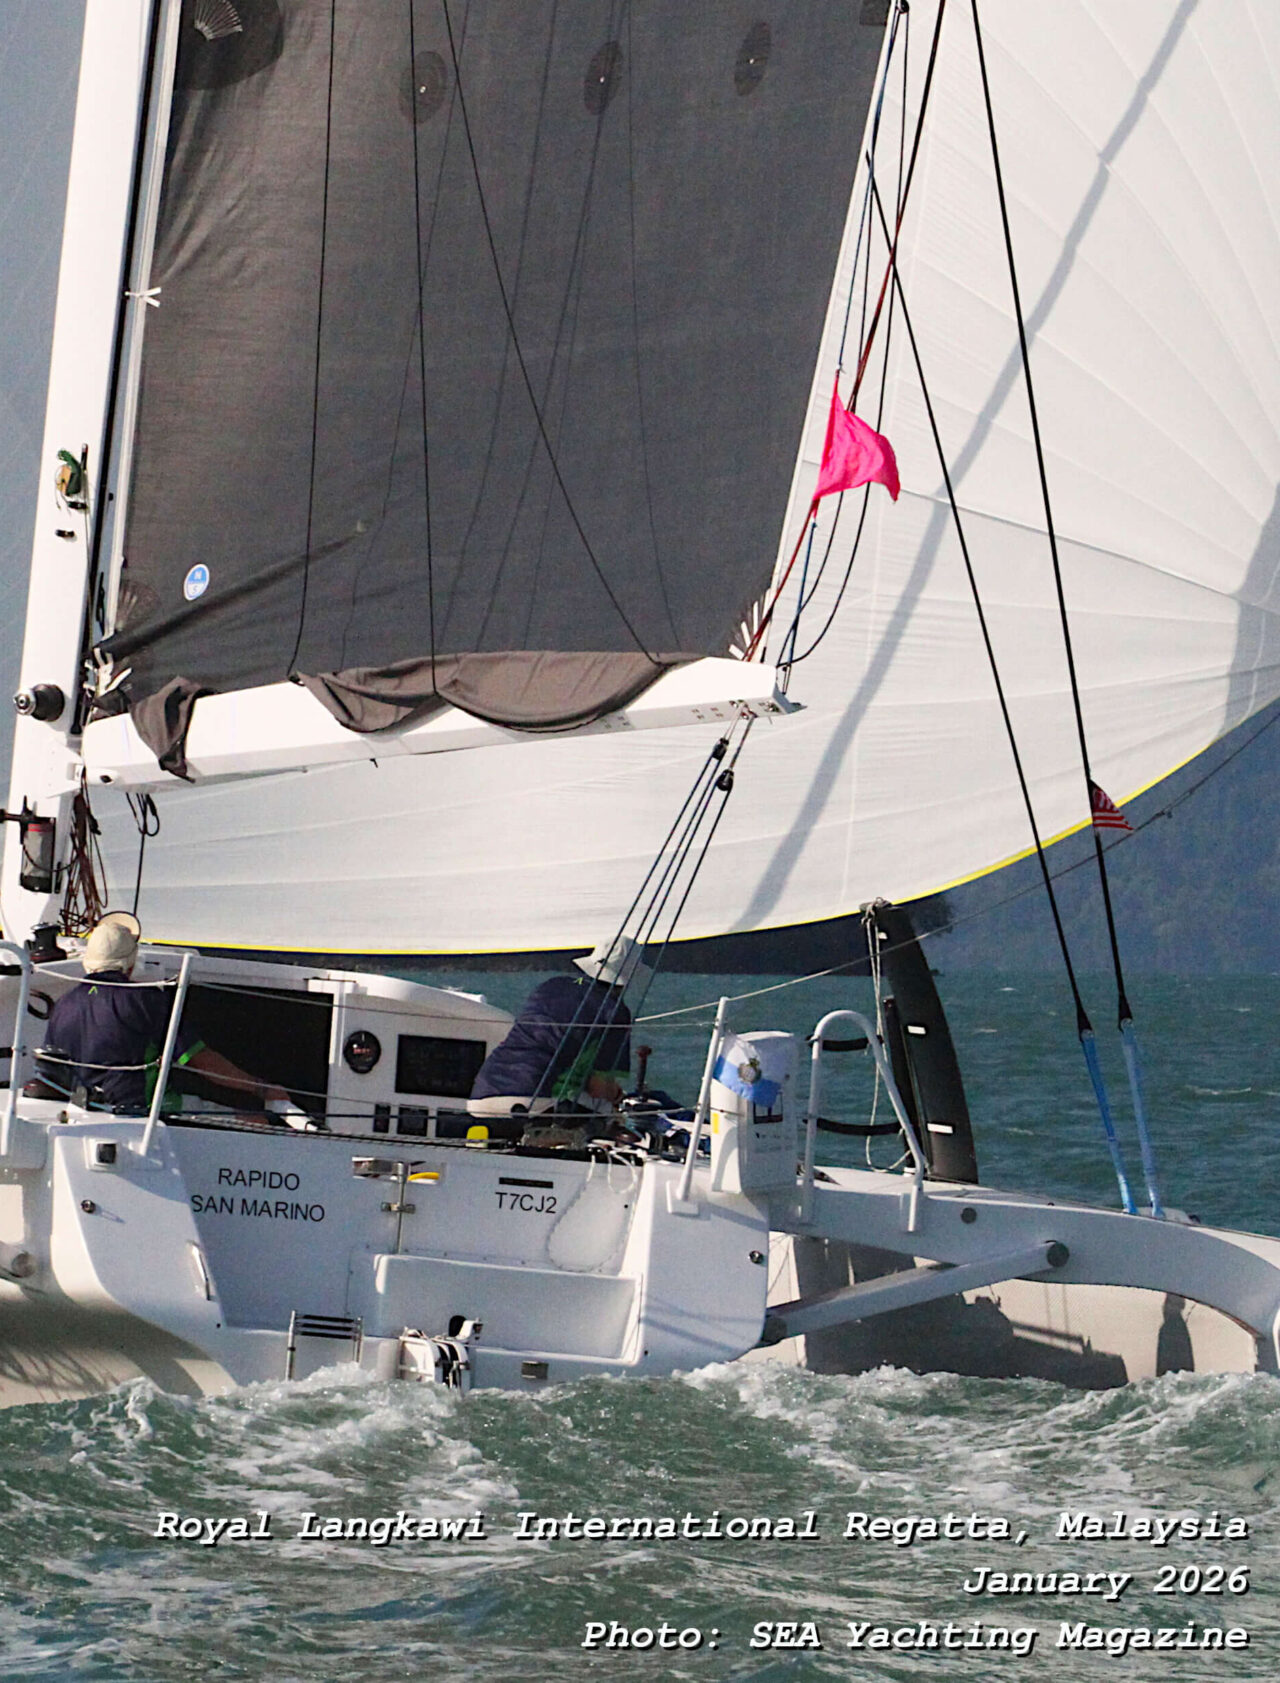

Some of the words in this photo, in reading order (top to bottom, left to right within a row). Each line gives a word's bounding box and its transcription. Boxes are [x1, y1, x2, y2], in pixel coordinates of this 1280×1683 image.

[218, 1168, 300, 1191] RAPIDO
[190, 1194, 234, 1215] SAN
[240, 1198, 326, 1222] MARINO
[495, 1191, 558, 1214] T7CJ2
